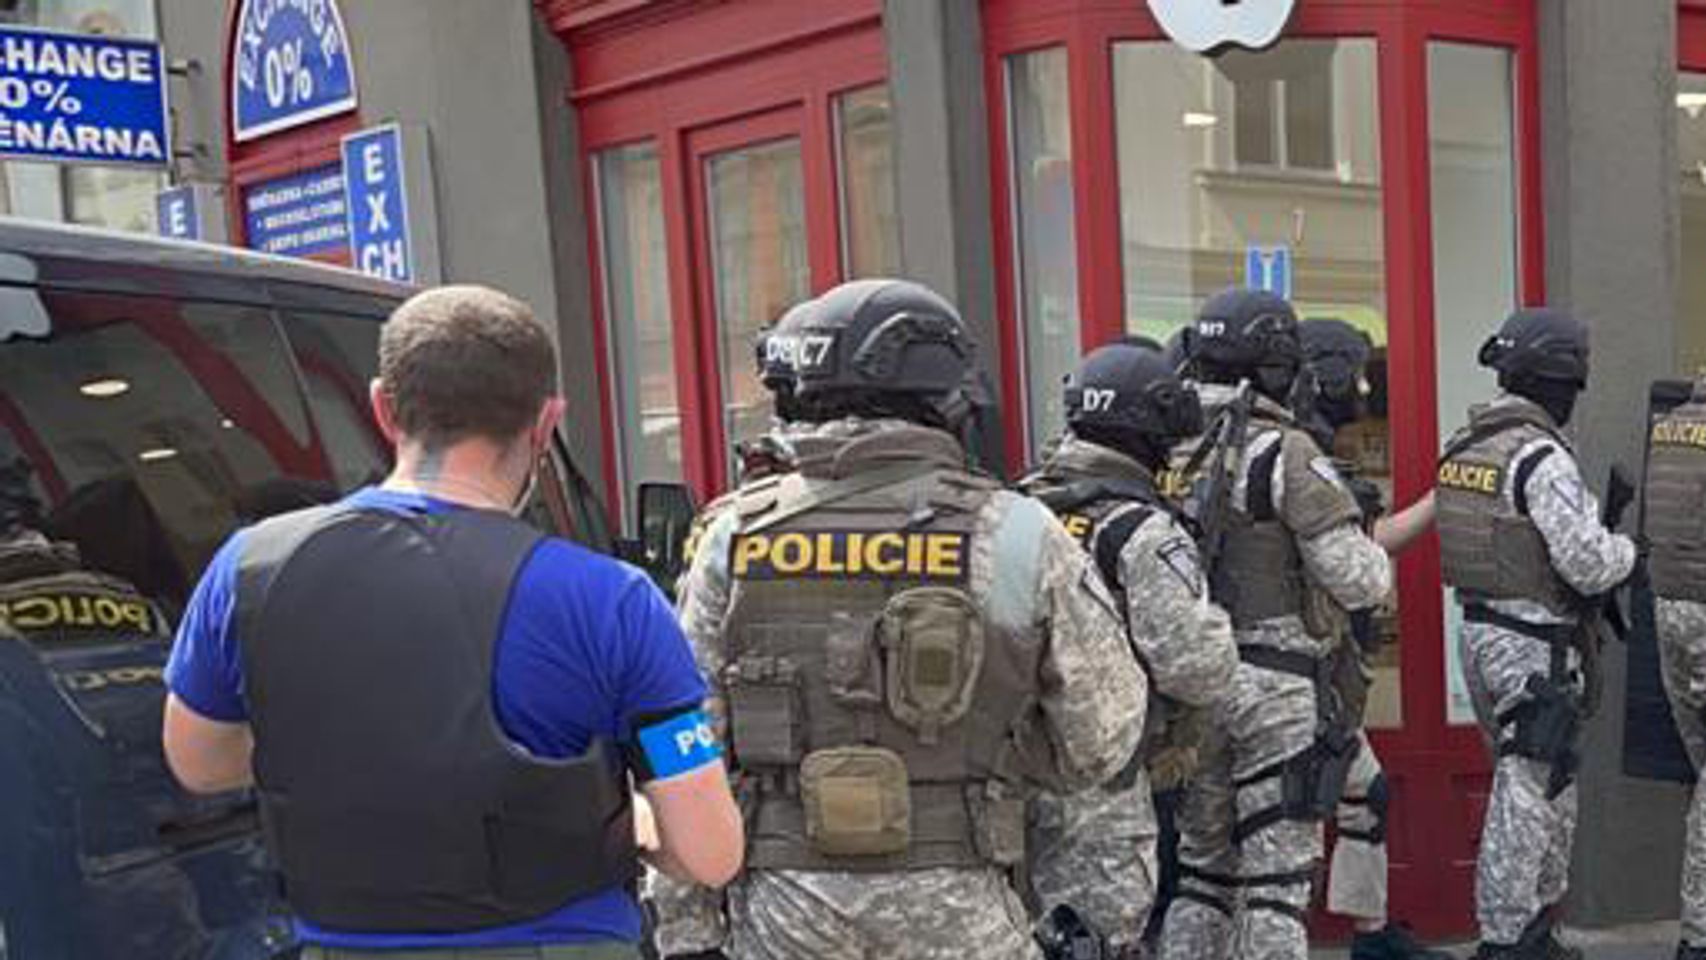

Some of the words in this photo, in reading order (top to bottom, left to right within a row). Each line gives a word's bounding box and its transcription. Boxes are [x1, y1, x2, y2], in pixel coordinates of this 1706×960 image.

[0, 37, 154, 83] HANGE
[265, 38, 312, 108] 0%
[0, 77, 82, 115] 0%
[800, 336, 834, 365] C7
[1083, 387, 1116, 412] D7
[733, 532, 962, 576] POLICIE
